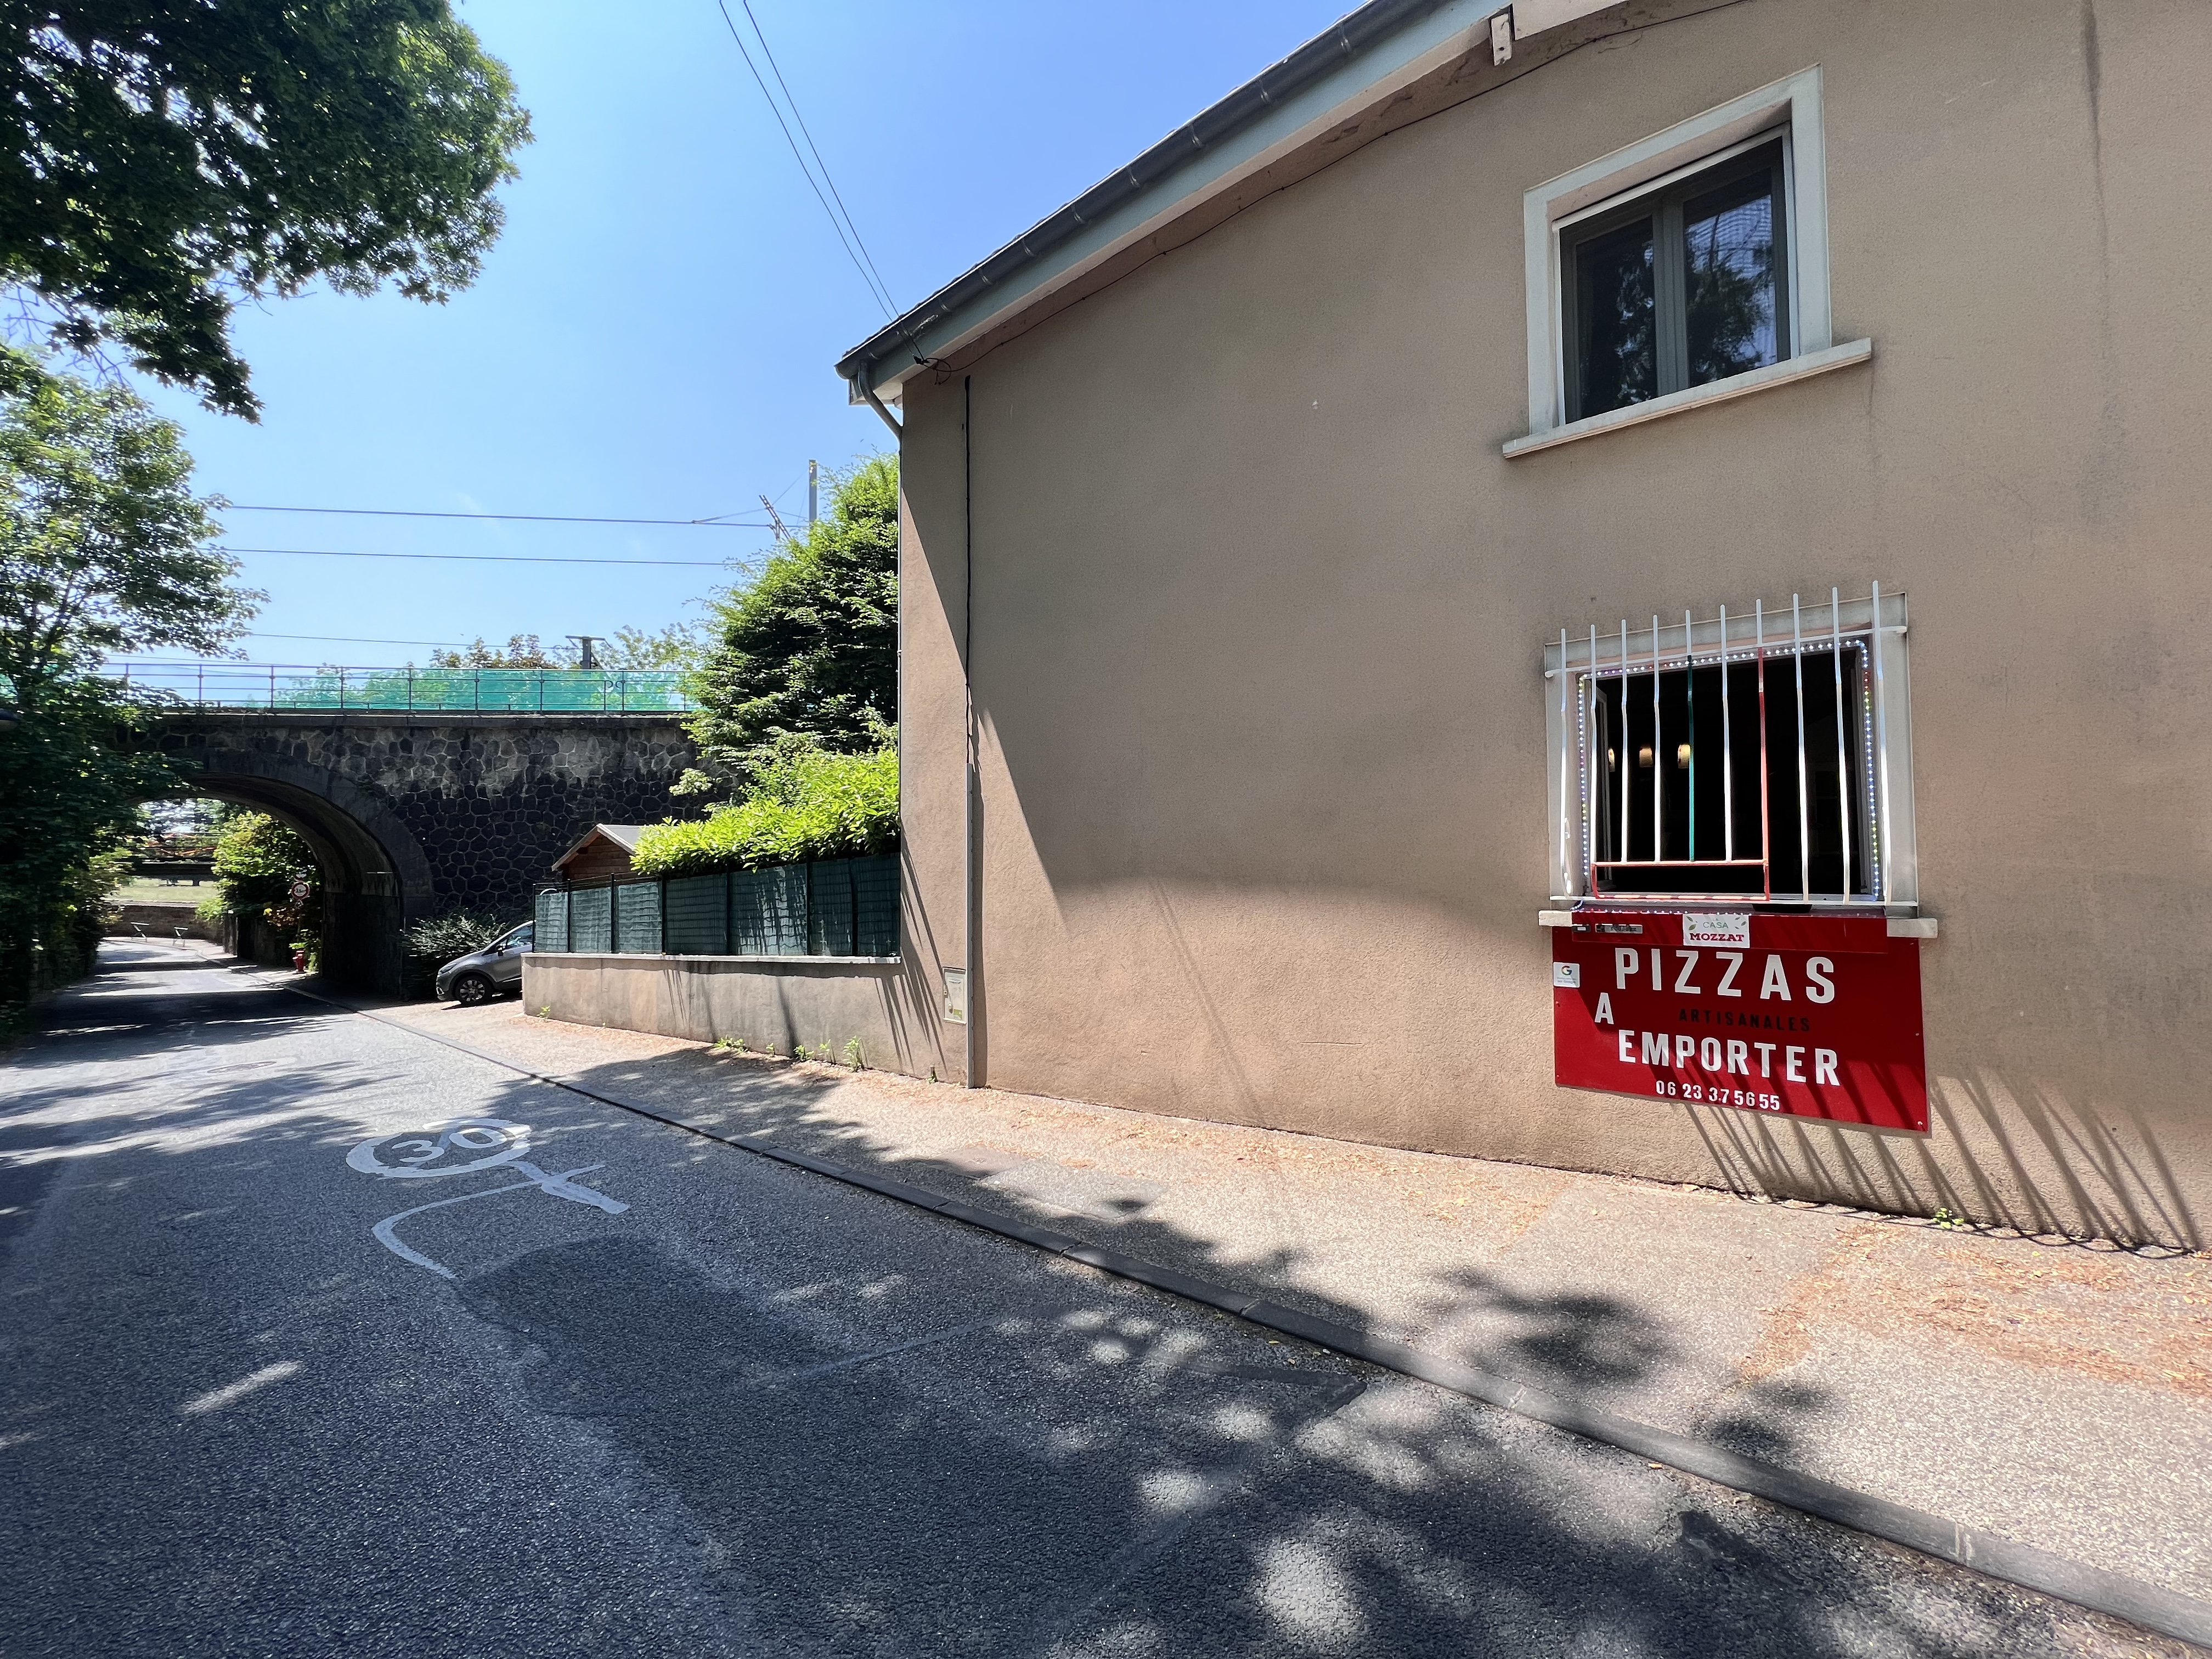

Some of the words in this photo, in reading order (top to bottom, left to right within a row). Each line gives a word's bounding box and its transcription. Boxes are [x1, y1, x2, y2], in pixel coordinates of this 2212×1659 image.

[1689, 933, 1745, 942] MOZZAT
[1561, 965, 1572, 975] G
[1615, 947, 1835, 1004] PIZZAS
[1594, 992, 1614, 1024] A
[1678, 1008, 1810, 1032] ARTISANALES
[1618, 1029, 1840, 1086] EMPORTER
[1656, 1080, 1676, 1096] 06
[1682, 1083, 1702, 1099] 23
[391, 1127, 508, 1163] 30
